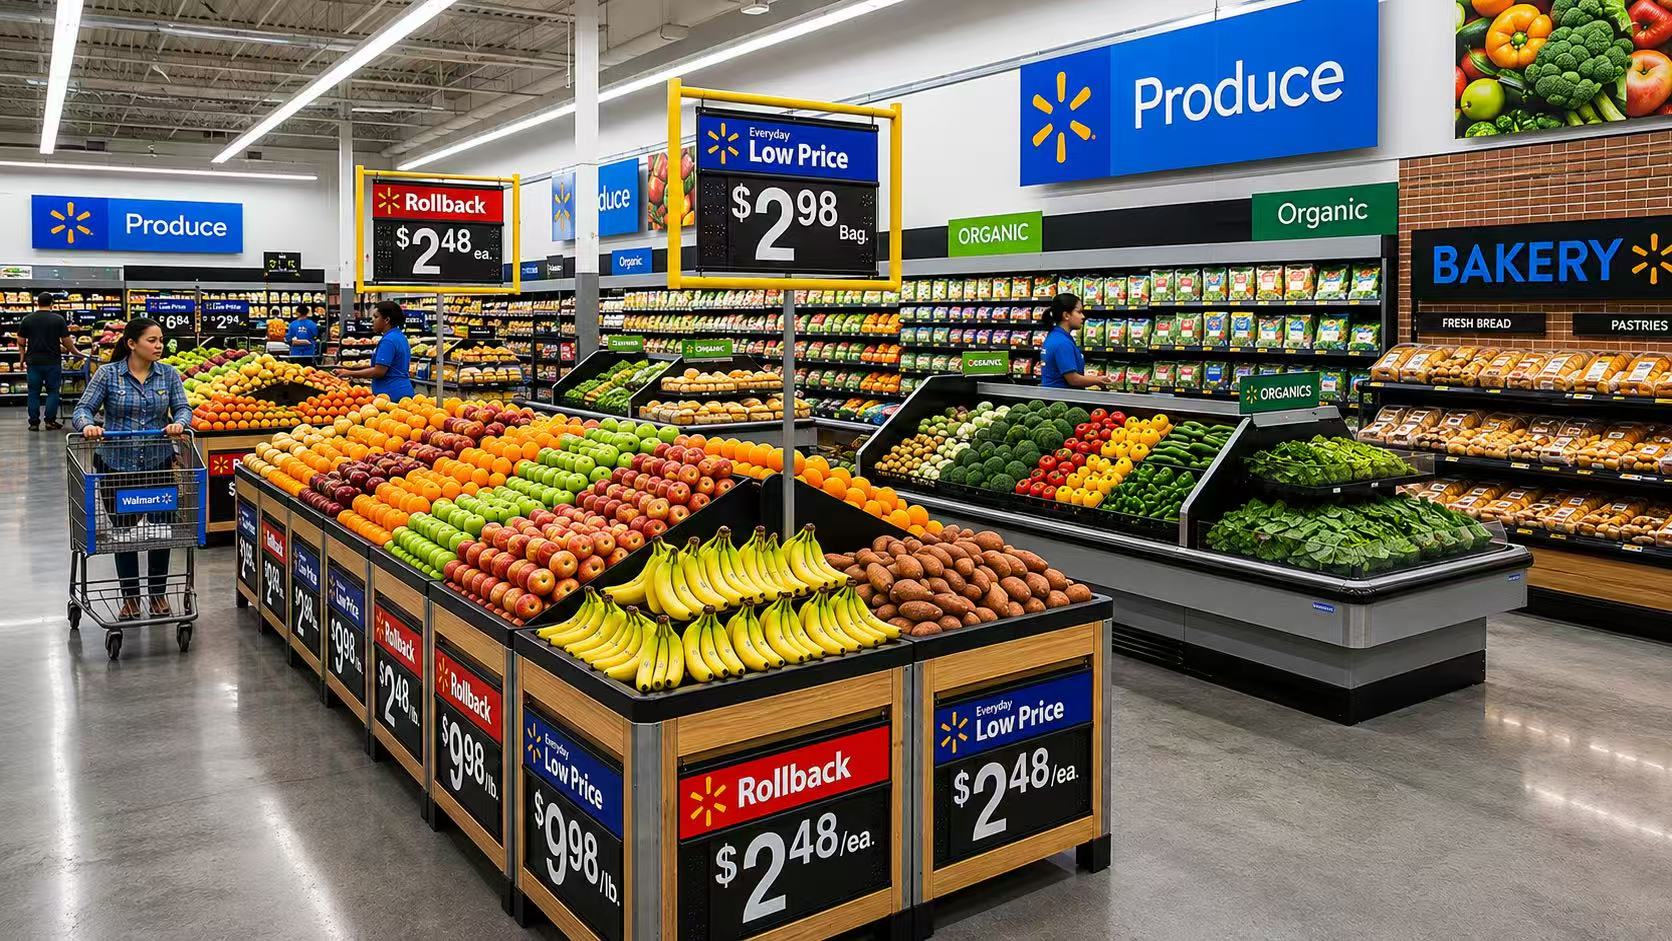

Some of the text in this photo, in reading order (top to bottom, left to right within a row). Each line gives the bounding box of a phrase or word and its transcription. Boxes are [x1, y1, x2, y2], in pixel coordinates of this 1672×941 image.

[1135, 59, 1345, 129] Produce
[749, 127, 790, 142] Everyday
[749, 139, 849, 169] Low Price
[405, 193, 487, 214] Rollback
[598, 185, 631, 211] duce
[1277, 197, 1368, 229] Organic
[126, 213, 227, 237] Produce
[839, 224, 869, 245] Bag.
[958, 223, 1029, 245] ORGANIC
[474, 251, 493, 260] ea.
[619, 255, 643, 270] Organic
[1433, 238, 1624, 284] BAKERY
[1442, 317, 1512, 330] FRESH BREAD
[1611, 320, 1669, 331] PASTRIES
[1260, 385, 1312, 400] ORGANICS
[122, 494, 161, 506] Walmart
[384, 620, 416, 665] Rollback
[450, 671, 492, 725] Rollback
[976, 700, 1013, 717] Everyday
[976, 699, 1065, 742] Low Price
[544, 746, 603, 810] Low Price
[738, 750, 852, 808] Rollback
